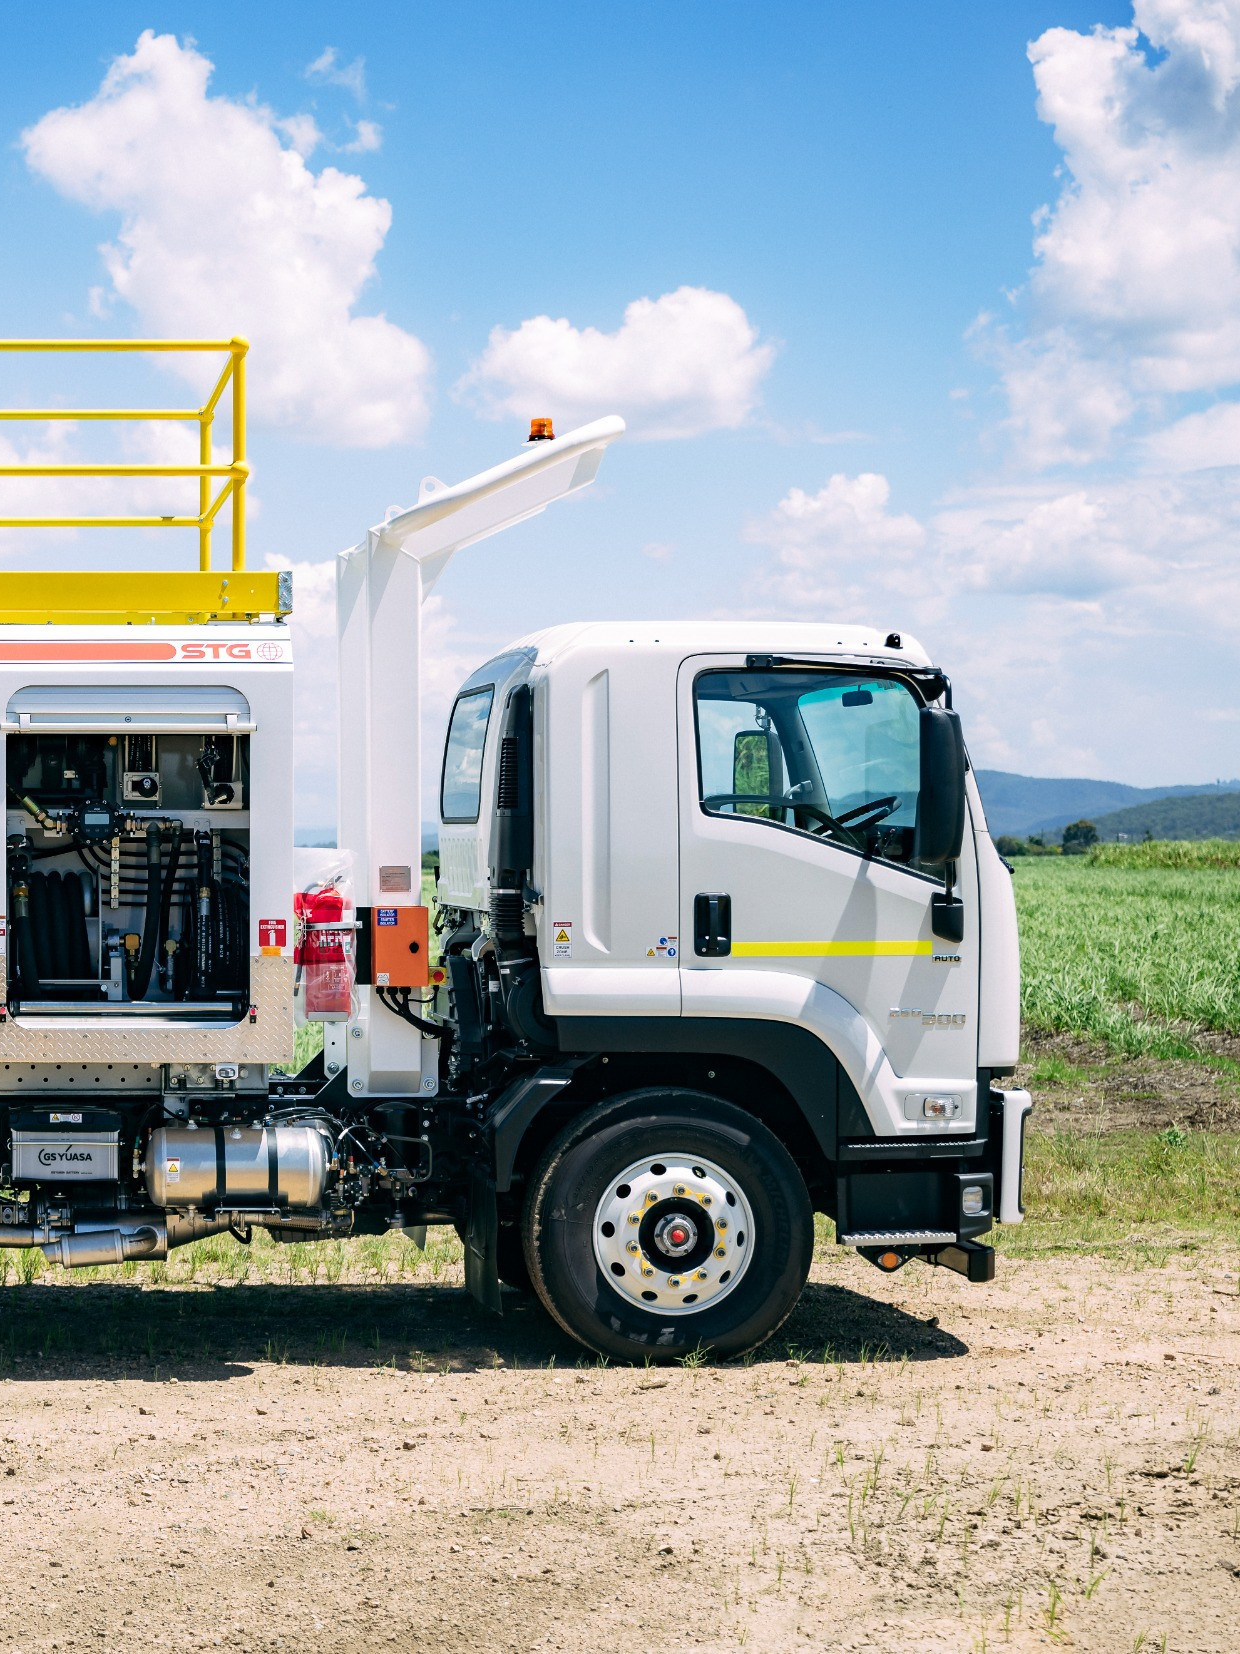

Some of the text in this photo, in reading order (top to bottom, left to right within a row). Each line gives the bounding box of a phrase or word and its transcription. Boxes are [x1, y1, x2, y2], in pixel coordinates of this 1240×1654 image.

[181, 643, 252, 660] STG
[921, 1012, 966, 1025] 300
[58, 1148, 93, 1161] YUASA
